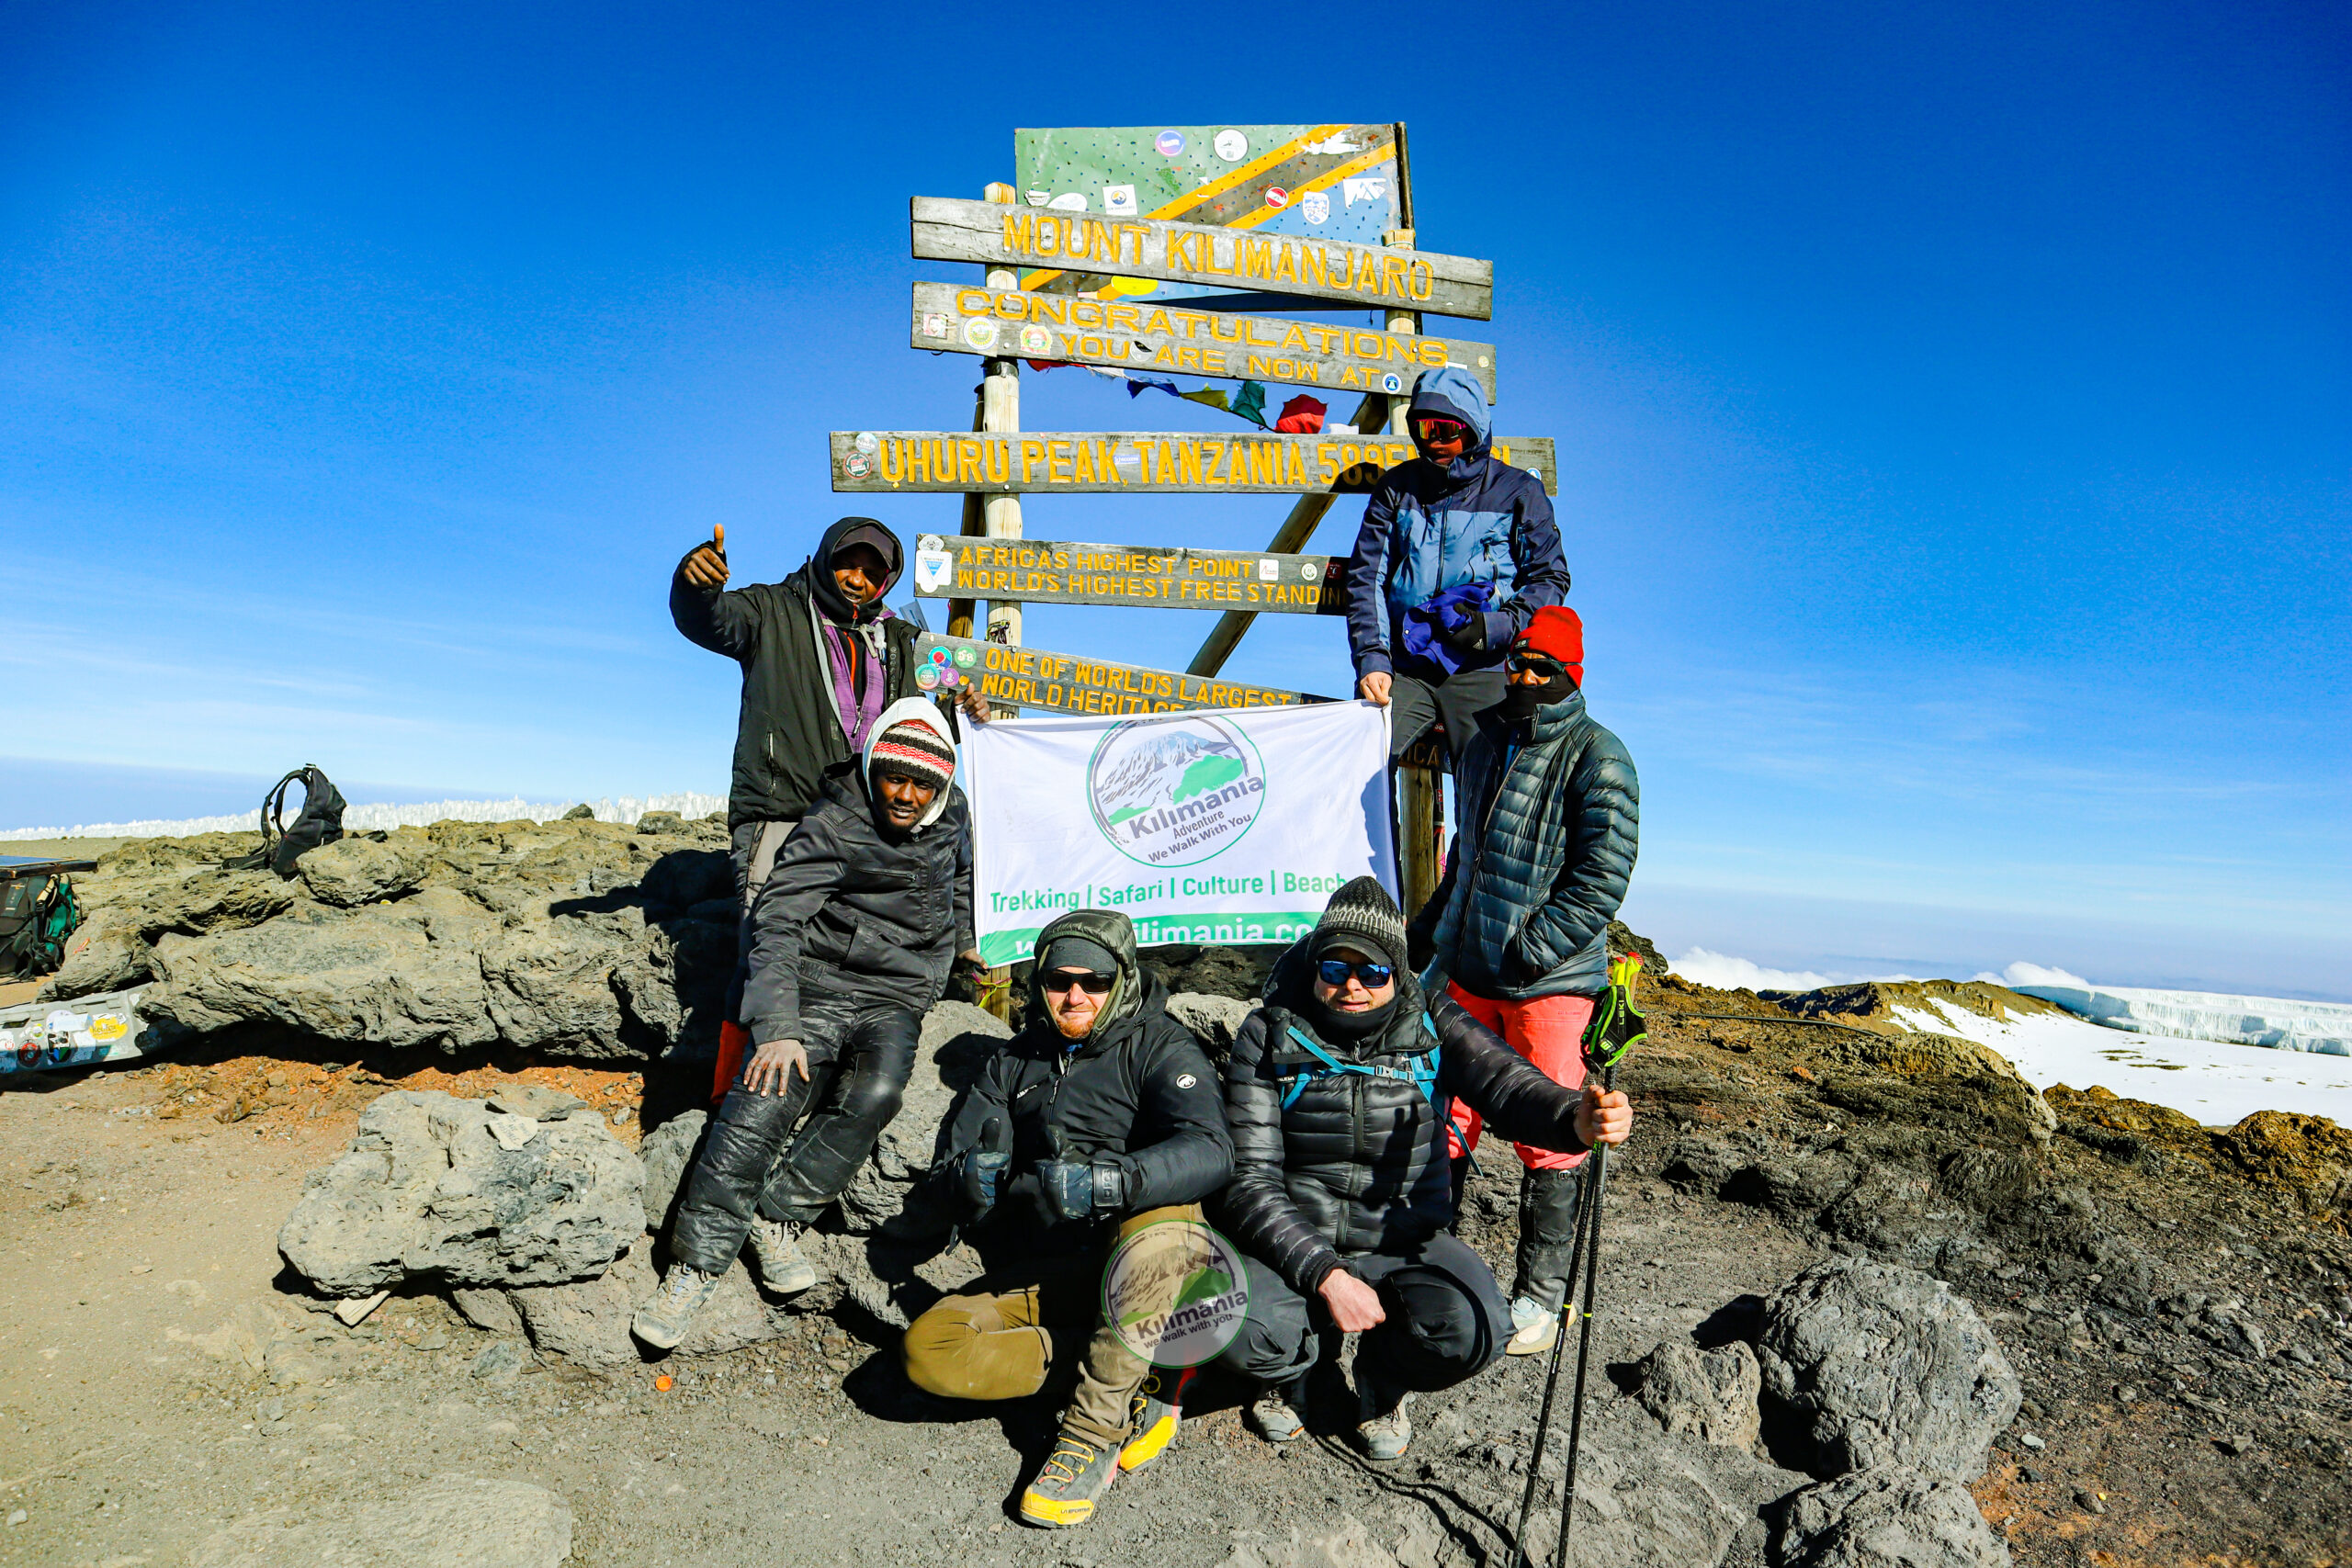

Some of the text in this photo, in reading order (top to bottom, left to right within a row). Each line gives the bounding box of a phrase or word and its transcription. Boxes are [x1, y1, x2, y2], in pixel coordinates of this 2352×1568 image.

[1003, 213, 1433, 301] MOUNT KILIMANJARO
[956, 290, 1449, 367] CONGRATULATIONS
[1059, 333, 1129, 360] YOU
[1155, 344, 1226, 372] ARE
[1249, 355, 1318, 382] NOW
[1341, 366, 1380, 388] AT
[879, 439, 1010, 483] UHURU
[1022, 440, 1128, 487] PEAK,
[1133, 441, 1313, 488] TANZANIA,
[958, 570, 1346, 605] WORLD'S HIGHEST FREE STANDIN
[1077, 552, 1176, 574] HIGHEST
[1188, 558, 1255, 578] POINT
[981, 673, 1062, 706] WORLD
[986, 648, 1035, 675] ONE
[1040, 657, 1069, 680] OF
[1075, 661, 1172, 697] WORLD'S
[1179, 678, 1291, 707] LARGEST
[1128, 776, 1264, 839] Kilimania
[1173, 810, 1225, 840] Adventure
[1148, 813, 1252, 863] We Walk With You
[990, 888, 1080, 912] Trekking
[1098, 880, 1162, 907] Safari
[1182, 875, 1263, 896] Culture
